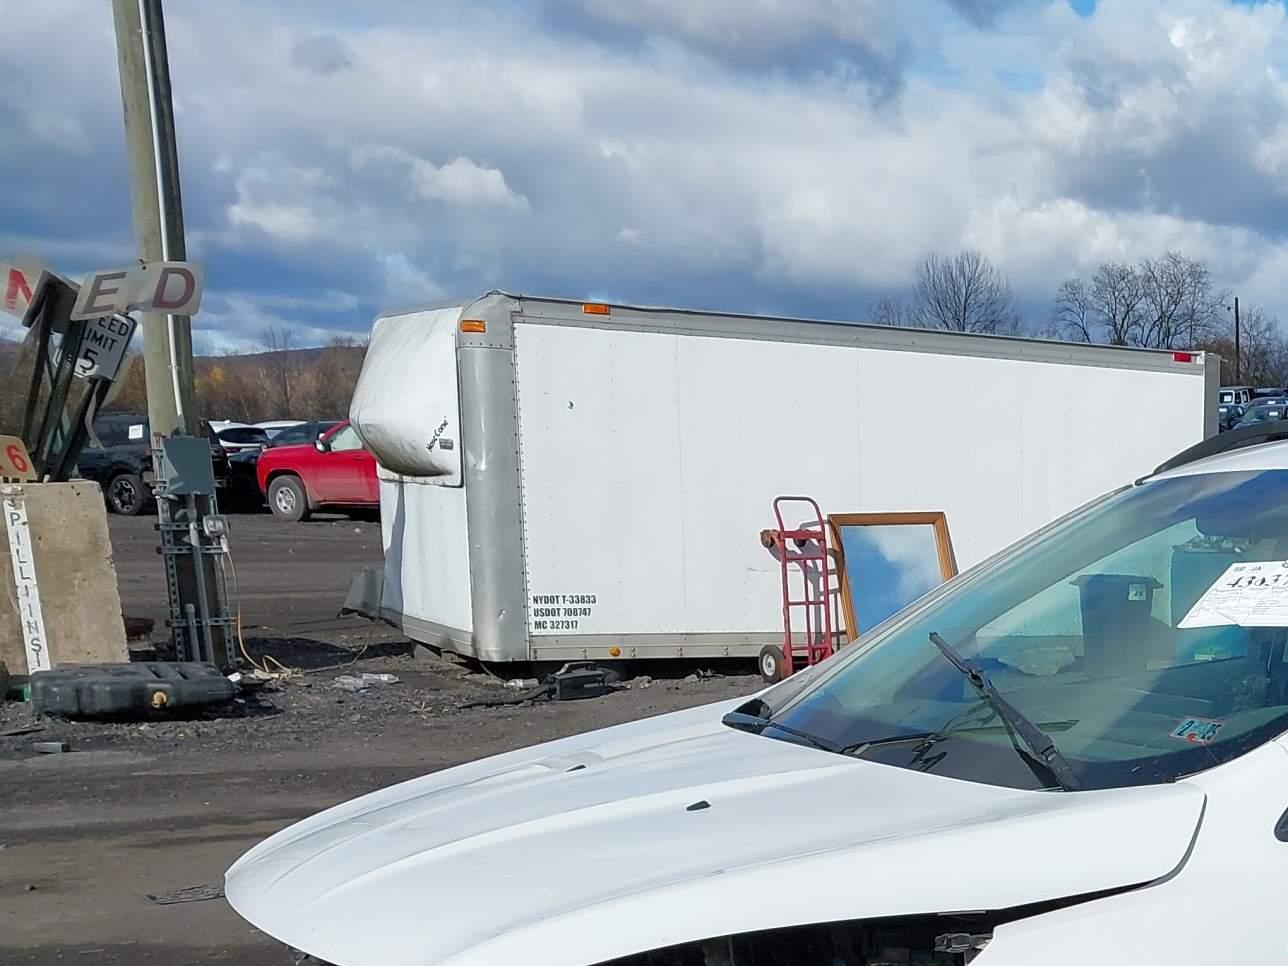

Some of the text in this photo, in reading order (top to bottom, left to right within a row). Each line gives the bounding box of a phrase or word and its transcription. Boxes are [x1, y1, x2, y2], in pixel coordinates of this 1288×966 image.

[98, 316, 129, 337] EED
[82, 328, 118, 352] IMIT
[0, 444, 28, 472] 6
[532, 595, 560, 605] NYDOT
[533, 607, 591, 617] USDOT 708747
[534, 619, 578, 630] MC 327317
